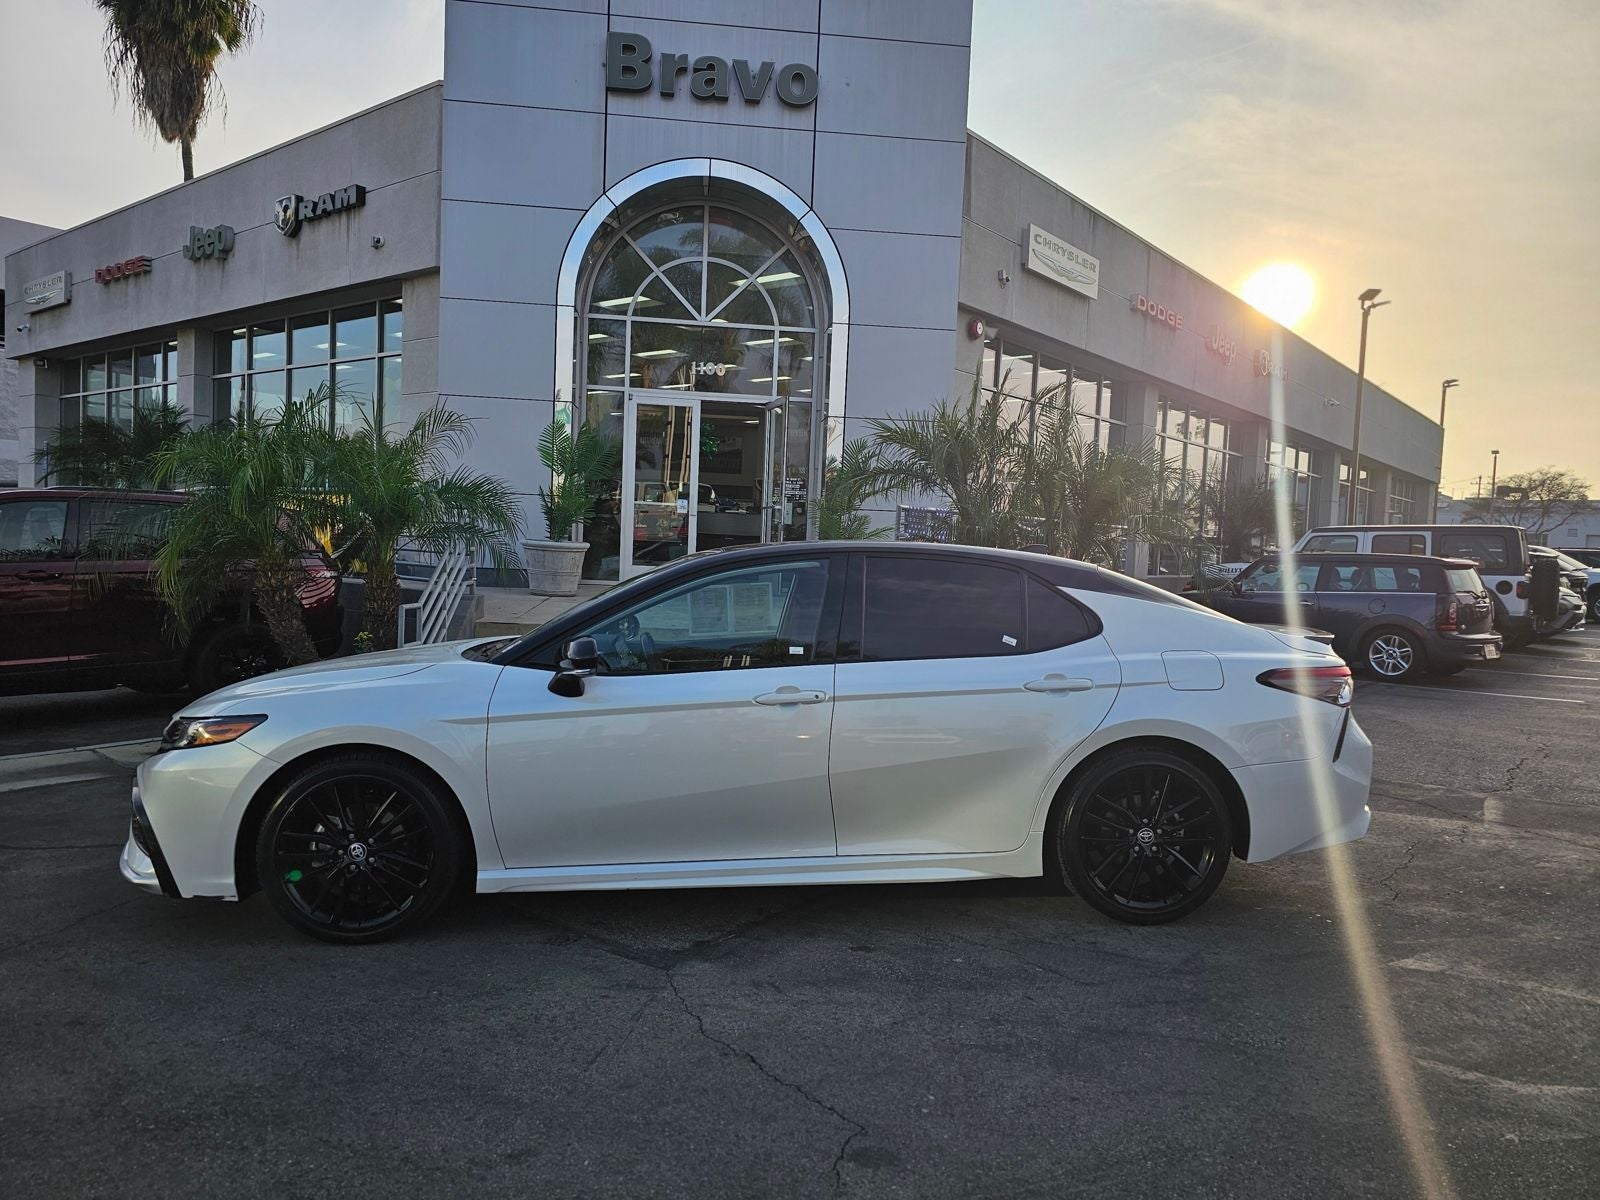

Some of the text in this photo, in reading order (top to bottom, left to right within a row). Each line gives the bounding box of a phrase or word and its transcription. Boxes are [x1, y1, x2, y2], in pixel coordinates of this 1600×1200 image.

[606, 31, 820, 108] Bravo
[298, 184, 366, 222] RAM
[183, 224, 235, 261] Jeep
[1033, 233, 1098, 274] CHRYSLER
[24, 275, 63, 295] CHRYSLER
[95, 255, 152, 285] DODGE
[1136, 294, 1185, 329] DODGE
[1212, 325, 1237, 364] Jeep
[690, 361, 726, 377] 1100
